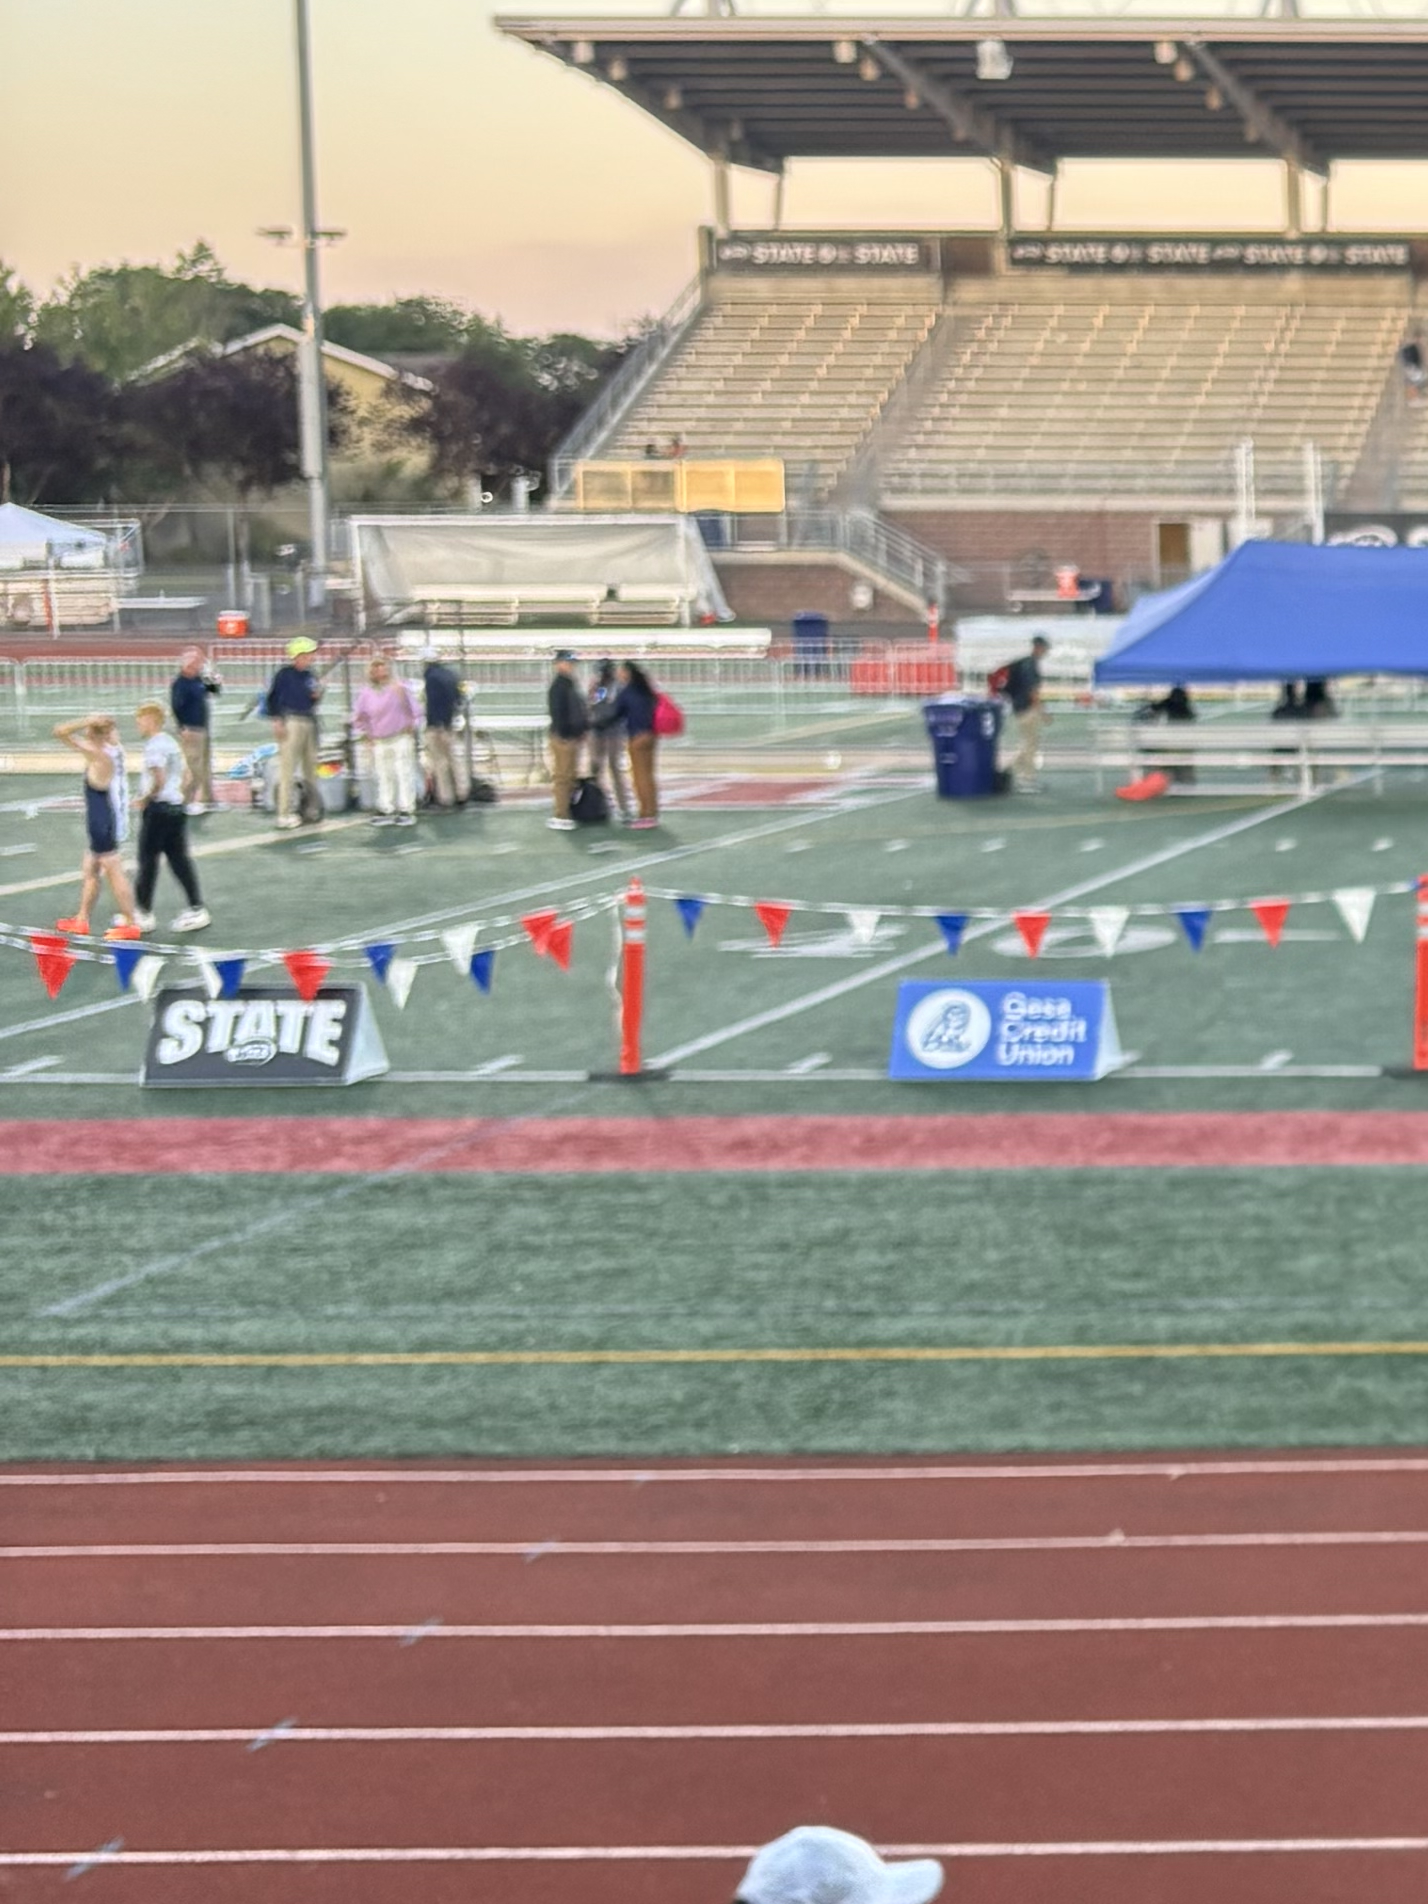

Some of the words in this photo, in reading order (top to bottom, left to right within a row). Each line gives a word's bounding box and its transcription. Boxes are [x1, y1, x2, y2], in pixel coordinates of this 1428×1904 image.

[1003, 991, 1072, 1021] Gesa
[155, 998, 347, 1066] STATE
[1002, 1016, 1087, 1043] Credit
[998, 1043, 1075, 1066] Union
